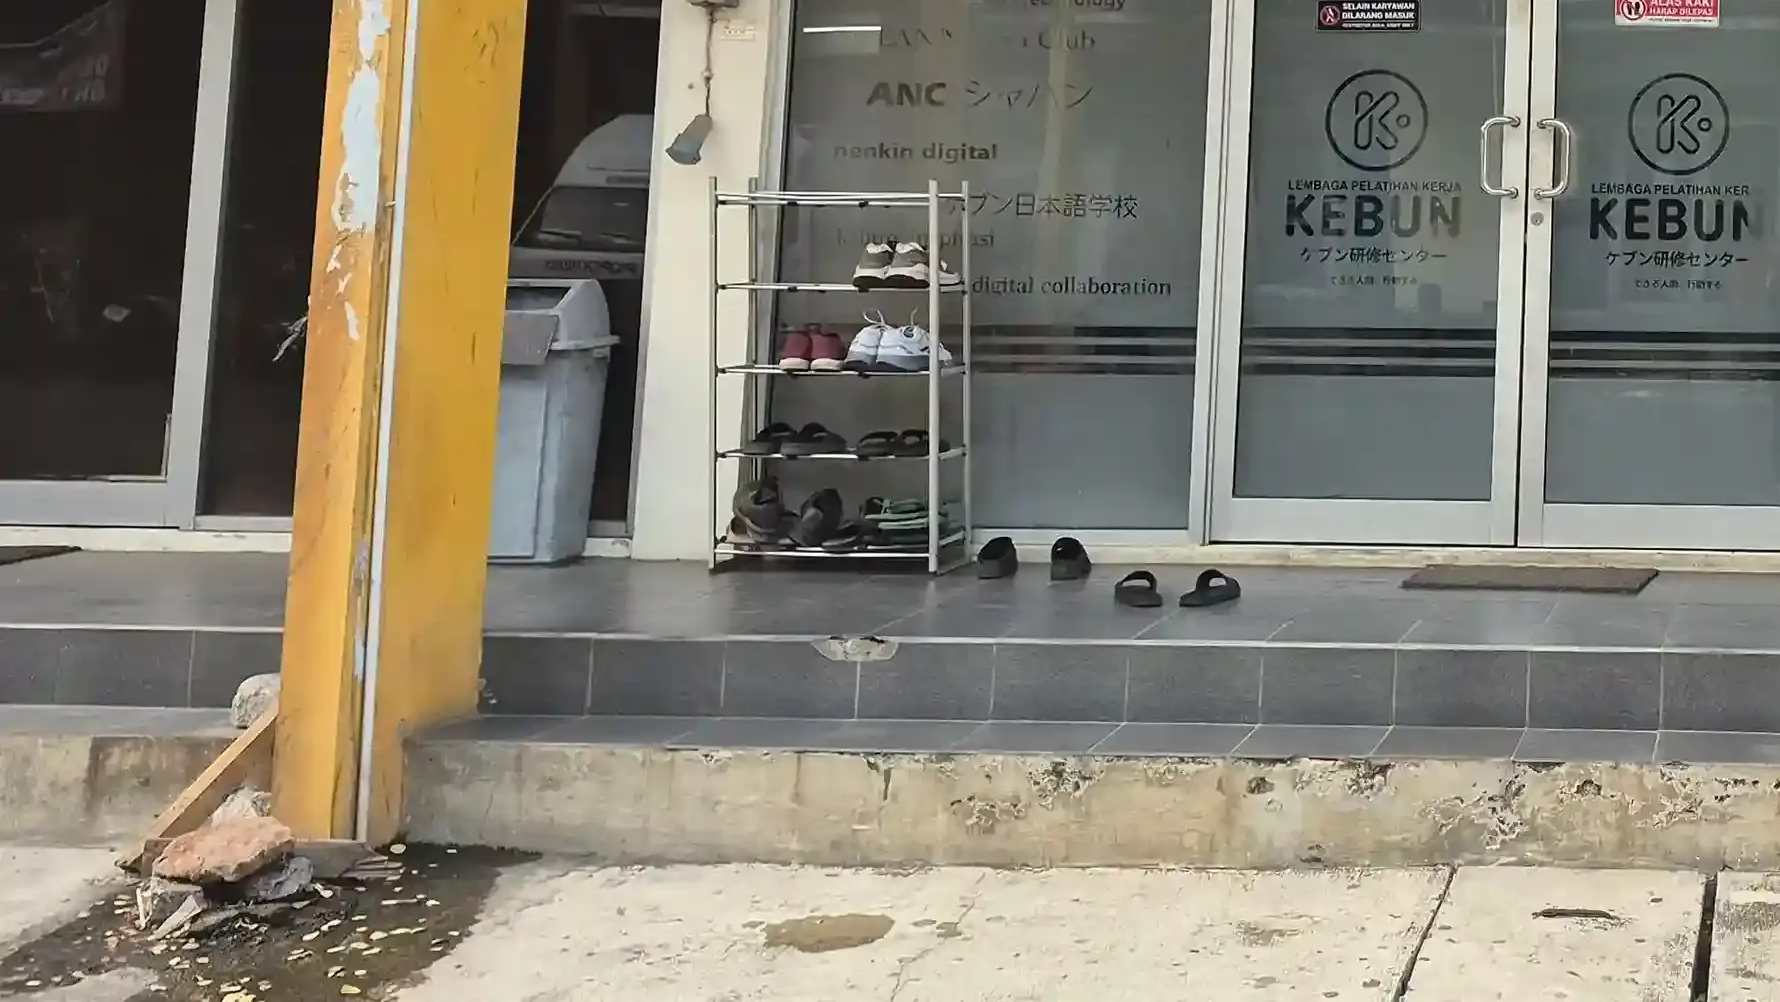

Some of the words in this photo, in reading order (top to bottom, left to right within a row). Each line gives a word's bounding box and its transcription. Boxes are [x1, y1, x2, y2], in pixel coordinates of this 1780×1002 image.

[1342, 2, 1370, 10] SELAIN
[1371, 2, 1415, 10] KARYAWAN
[1342, 11, 1383, 19] DILARANG
[1384, 11, 1415, 19] MASUK
[1649, 7, 1678, 16] HARAP
[1679, 7, 1714, 16] DILEPAS
[1038, 28, 1096, 50] Cub
[866, 81, 947, 107] ANC
[834, 142, 913, 160] nenkin
[922, 142, 998, 164] digital
[1288, 179, 1349, 192] LEMBAGA
[1351, 180, 1419, 193] PELATIHAN
[1422, 181, 1463, 194] KERJA
[1591, 183, 1651, 195] LEMBAGA
[1654, 184, 1721, 196] PELATIHAN
[1285, 193, 1462, 239] KEBUN
[1589, 197, 1765, 243] KEBUN
[971, 274, 1034, 295] digital
[1041, 274, 1172, 296] collaboration
